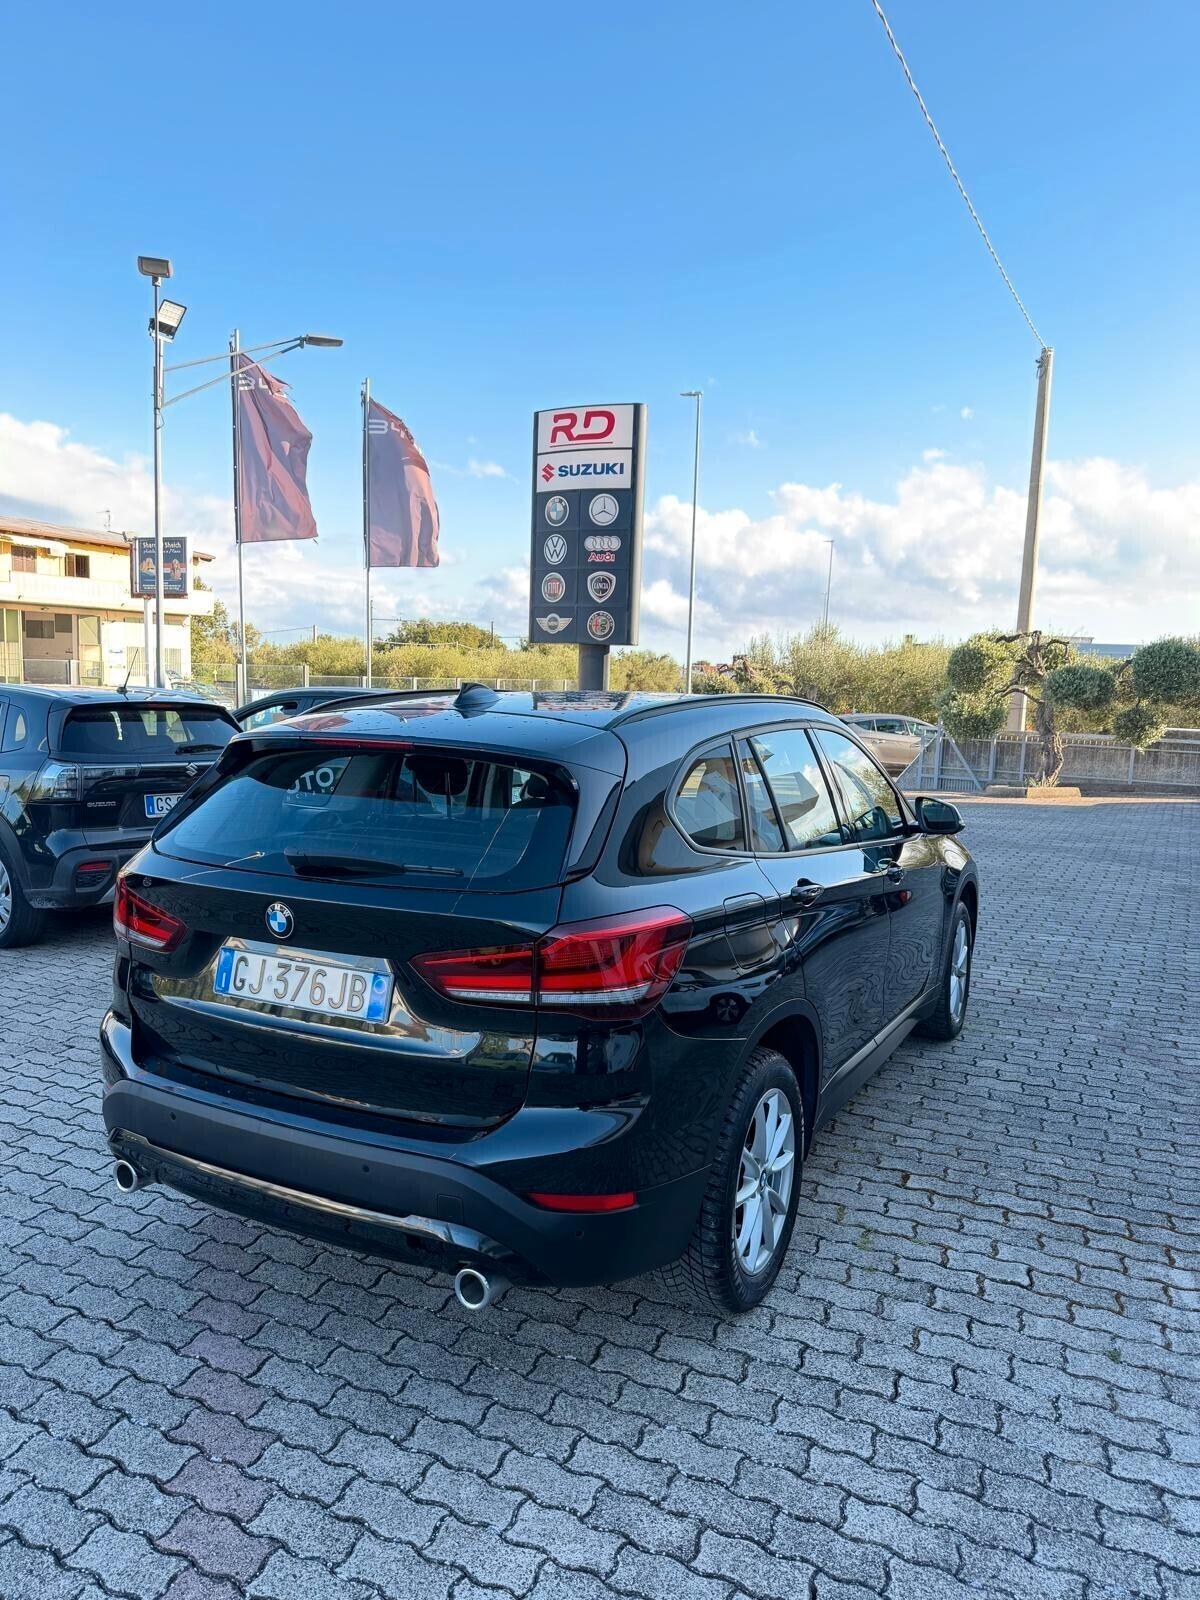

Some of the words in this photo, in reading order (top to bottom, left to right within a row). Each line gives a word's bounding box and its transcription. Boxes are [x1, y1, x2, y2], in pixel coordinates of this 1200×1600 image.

[550, 410, 616, 443] RD
[558, 462, 625, 477] SUZUKI
[587, 552, 616, 563] Audi
[232, 955, 266, 995] GJ
[273, 962, 367, 1013] 376JB
